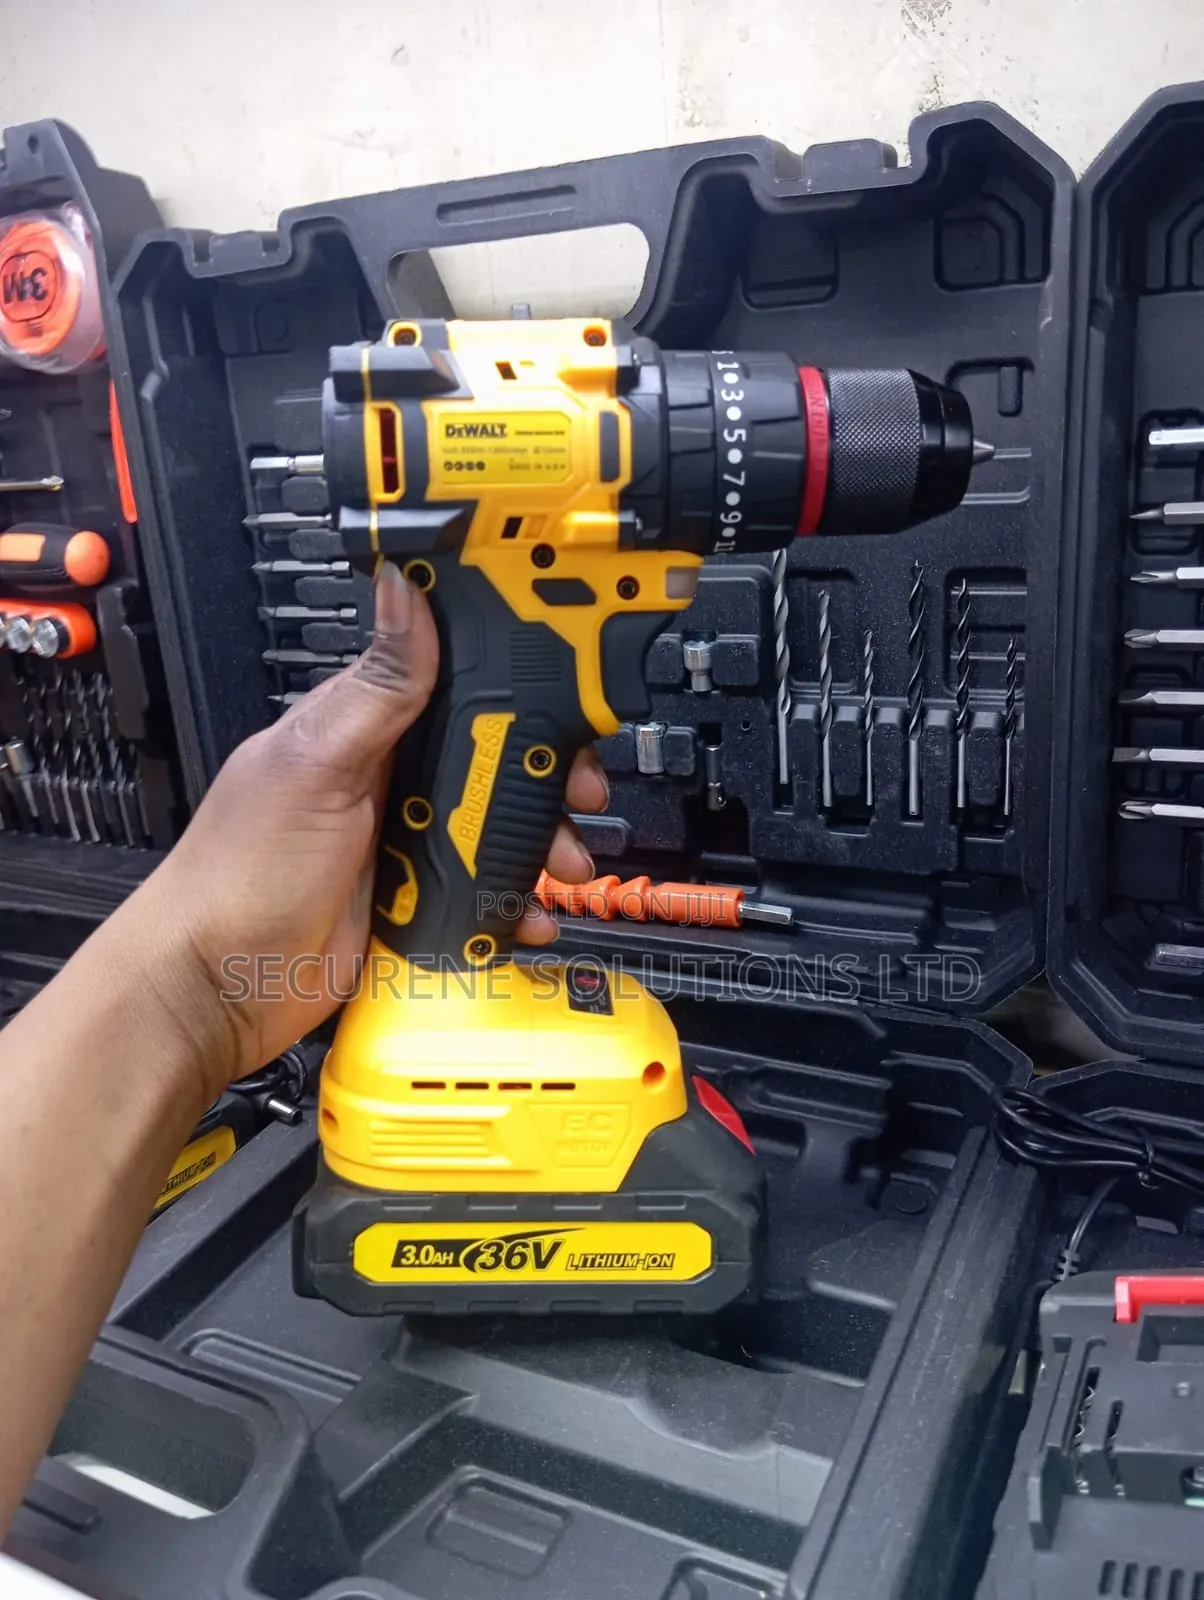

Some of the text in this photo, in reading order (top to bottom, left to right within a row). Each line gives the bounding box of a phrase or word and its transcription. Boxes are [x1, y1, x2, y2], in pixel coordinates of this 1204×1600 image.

[717, 362, 740, 371] 1
[721, 389, 744, 402] 3
[723, 428, 746, 442] 5
[722, 470, 745, 486] 7
[720, 511, 742, 523] 9
[459, 718, 504, 842] BRUSHLESS
[562, 1111, 613, 1131] EC
[478, 1239, 565, 1271] 36V
[566, 1253, 676, 1271] LITHIUM-ION
